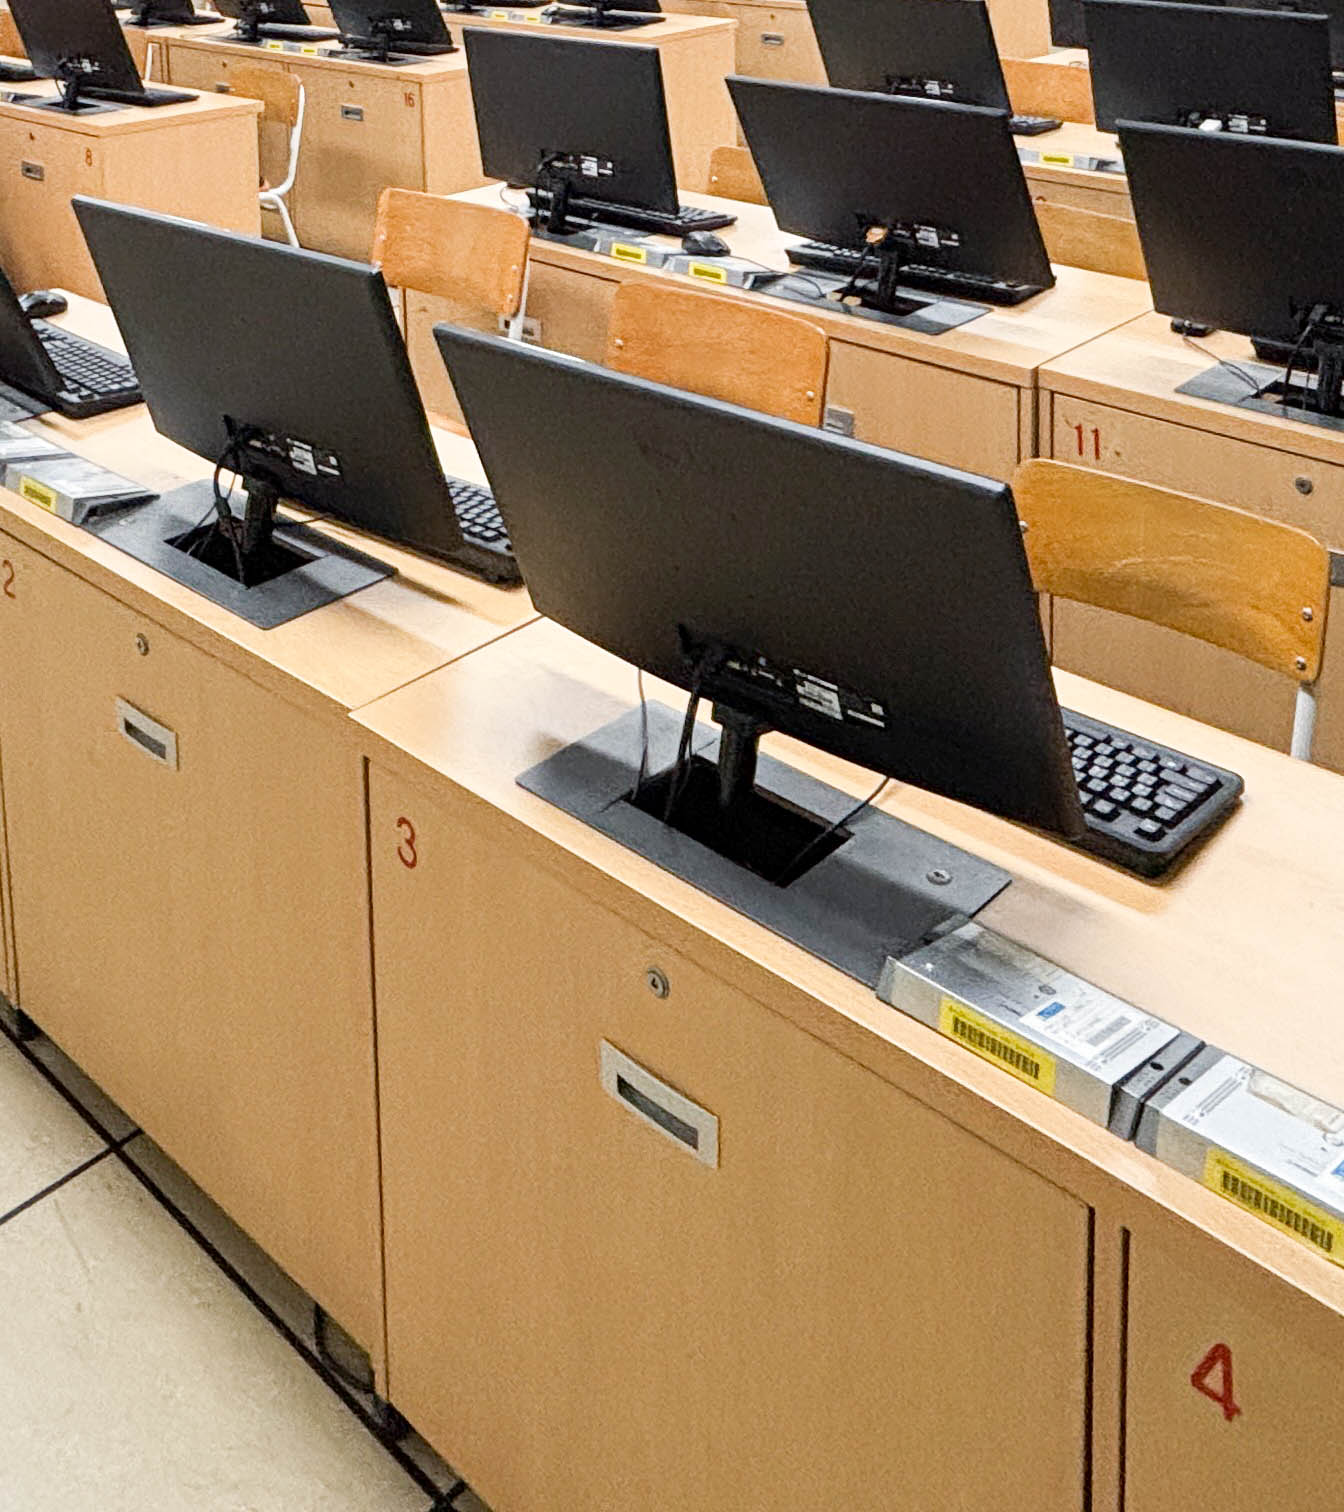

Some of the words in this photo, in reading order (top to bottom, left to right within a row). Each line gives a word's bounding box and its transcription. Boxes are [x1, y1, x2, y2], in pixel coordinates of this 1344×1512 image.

[404, 92, 416, 108] 16
[85, 146, 93, 168] 8
[1074, 423, 1101, 460] 11
[2, 559, 17, 600] 2
[396, 816, 418, 870] 3
[1190, 1342, 1244, 1424] 4
